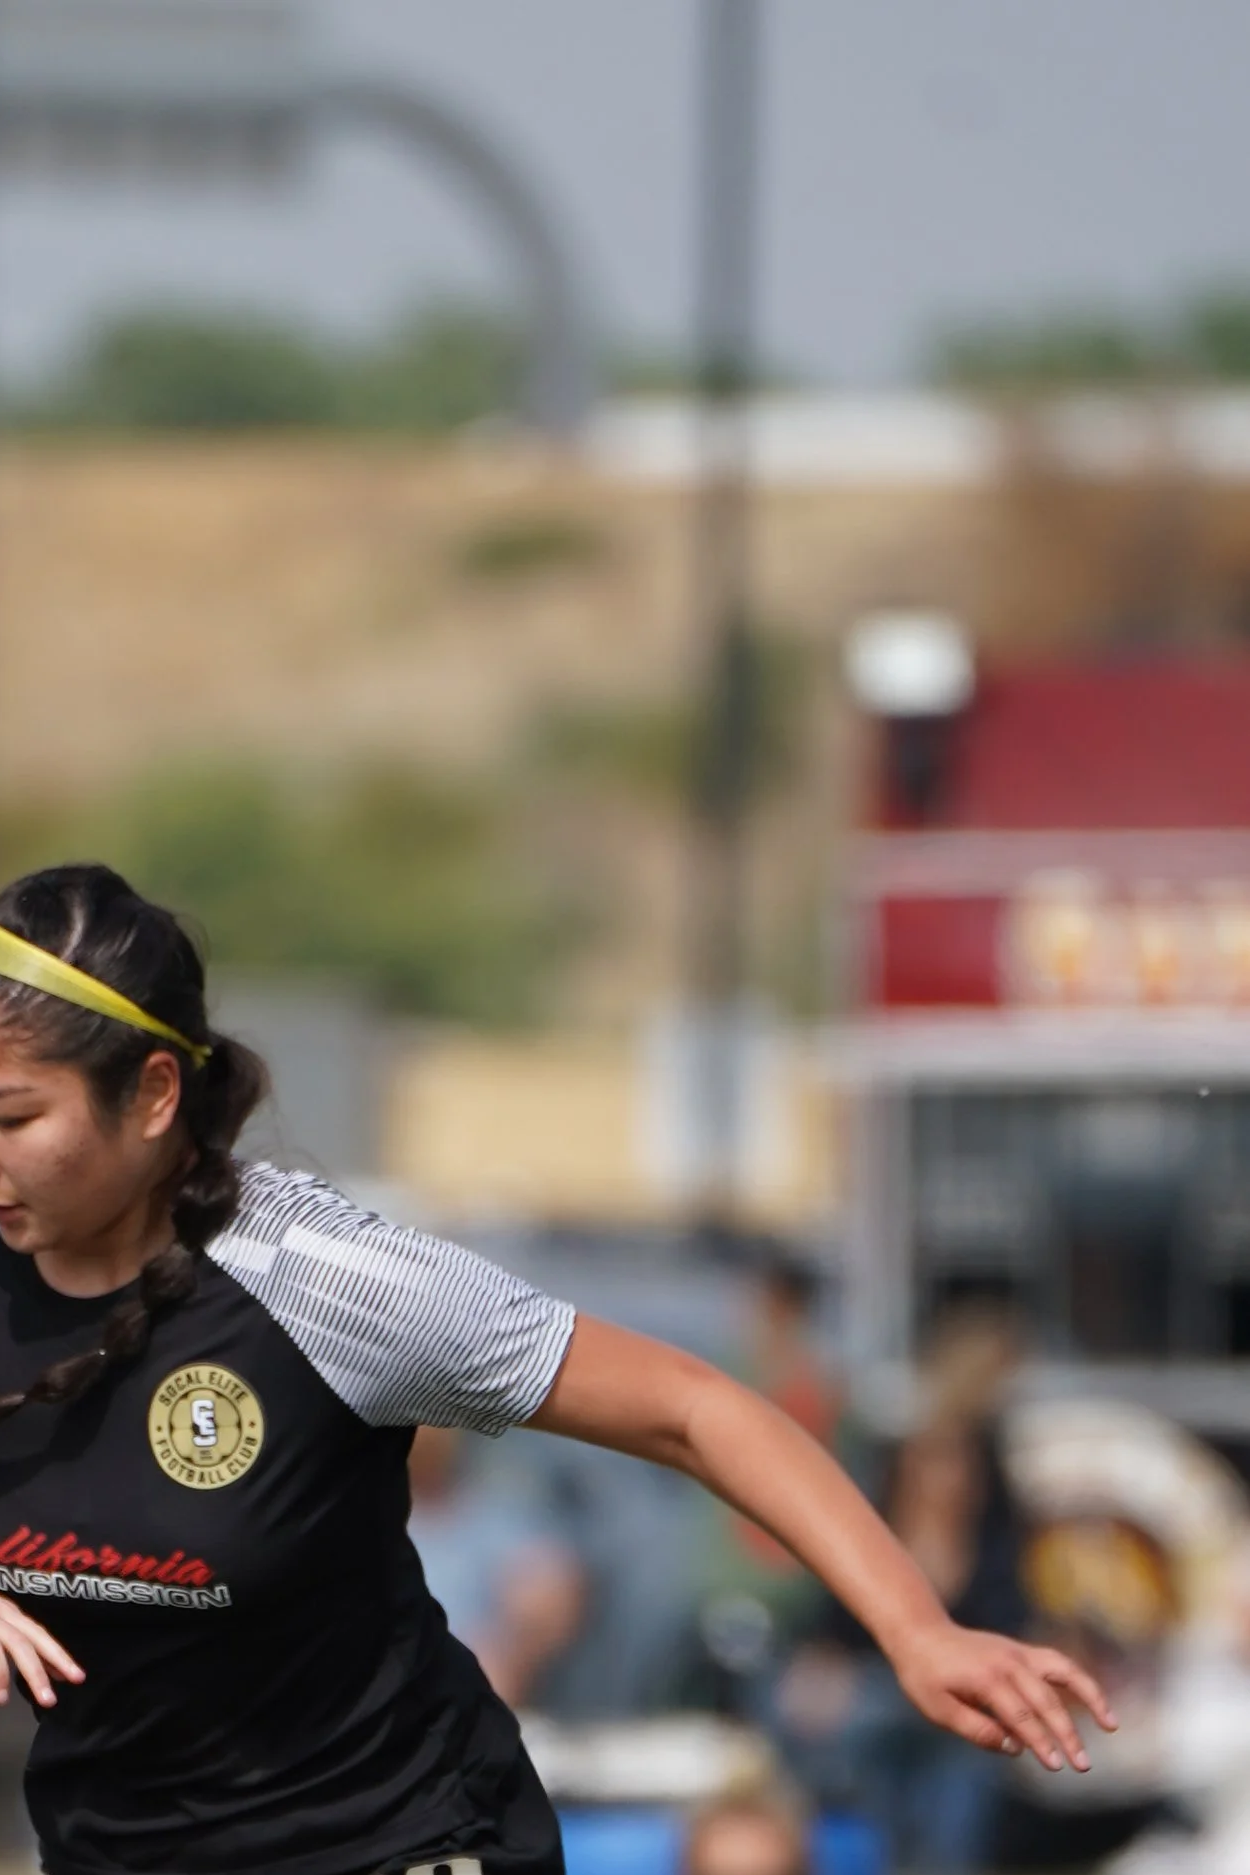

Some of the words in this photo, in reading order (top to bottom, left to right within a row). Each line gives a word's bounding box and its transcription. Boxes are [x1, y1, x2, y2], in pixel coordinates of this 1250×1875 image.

[158, 1370, 202, 1406] SOCAL
[208, 1371, 249, 1403] ELITE
[155, 1438, 226, 1485] FOOTBALL
[226, 1436, 258, 1476] CLUB
